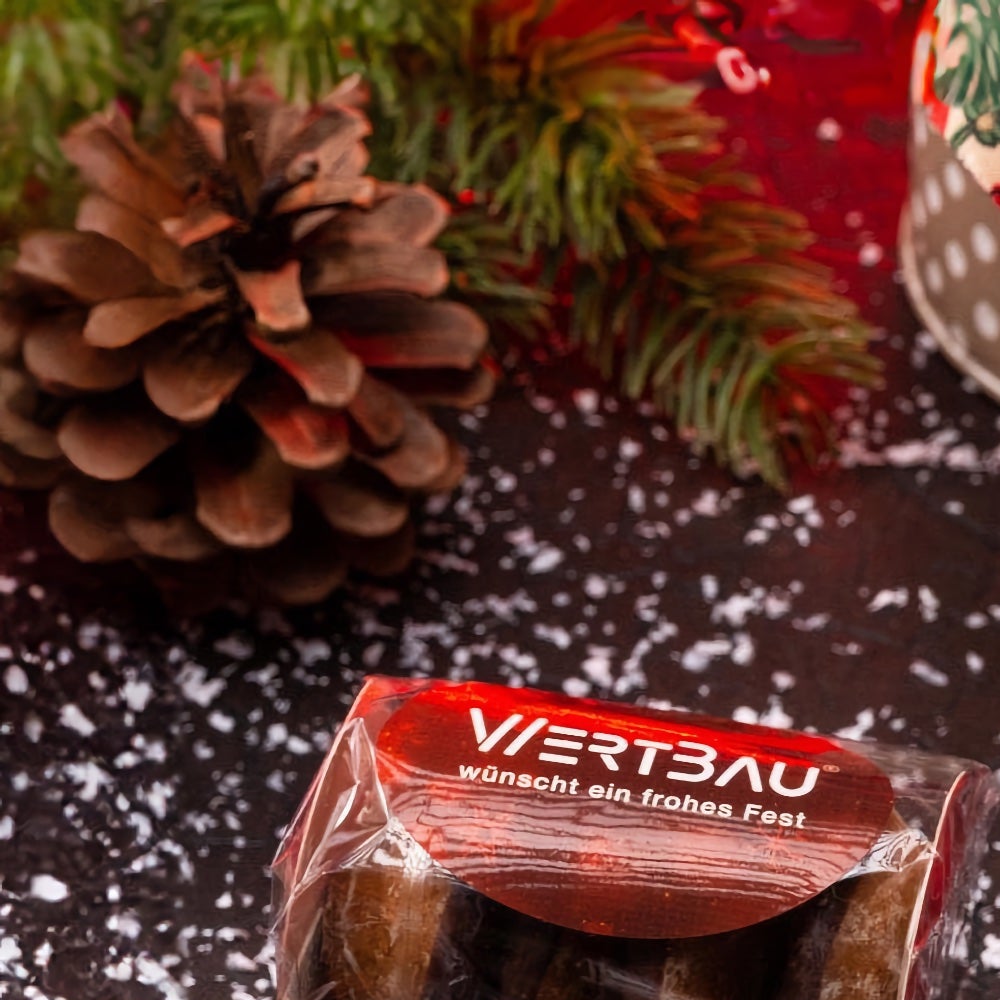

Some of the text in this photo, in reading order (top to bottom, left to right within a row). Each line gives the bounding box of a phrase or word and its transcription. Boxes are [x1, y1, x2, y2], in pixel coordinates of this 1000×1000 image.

[458, 763, 807, 830] wünscht ein frohes Fest
